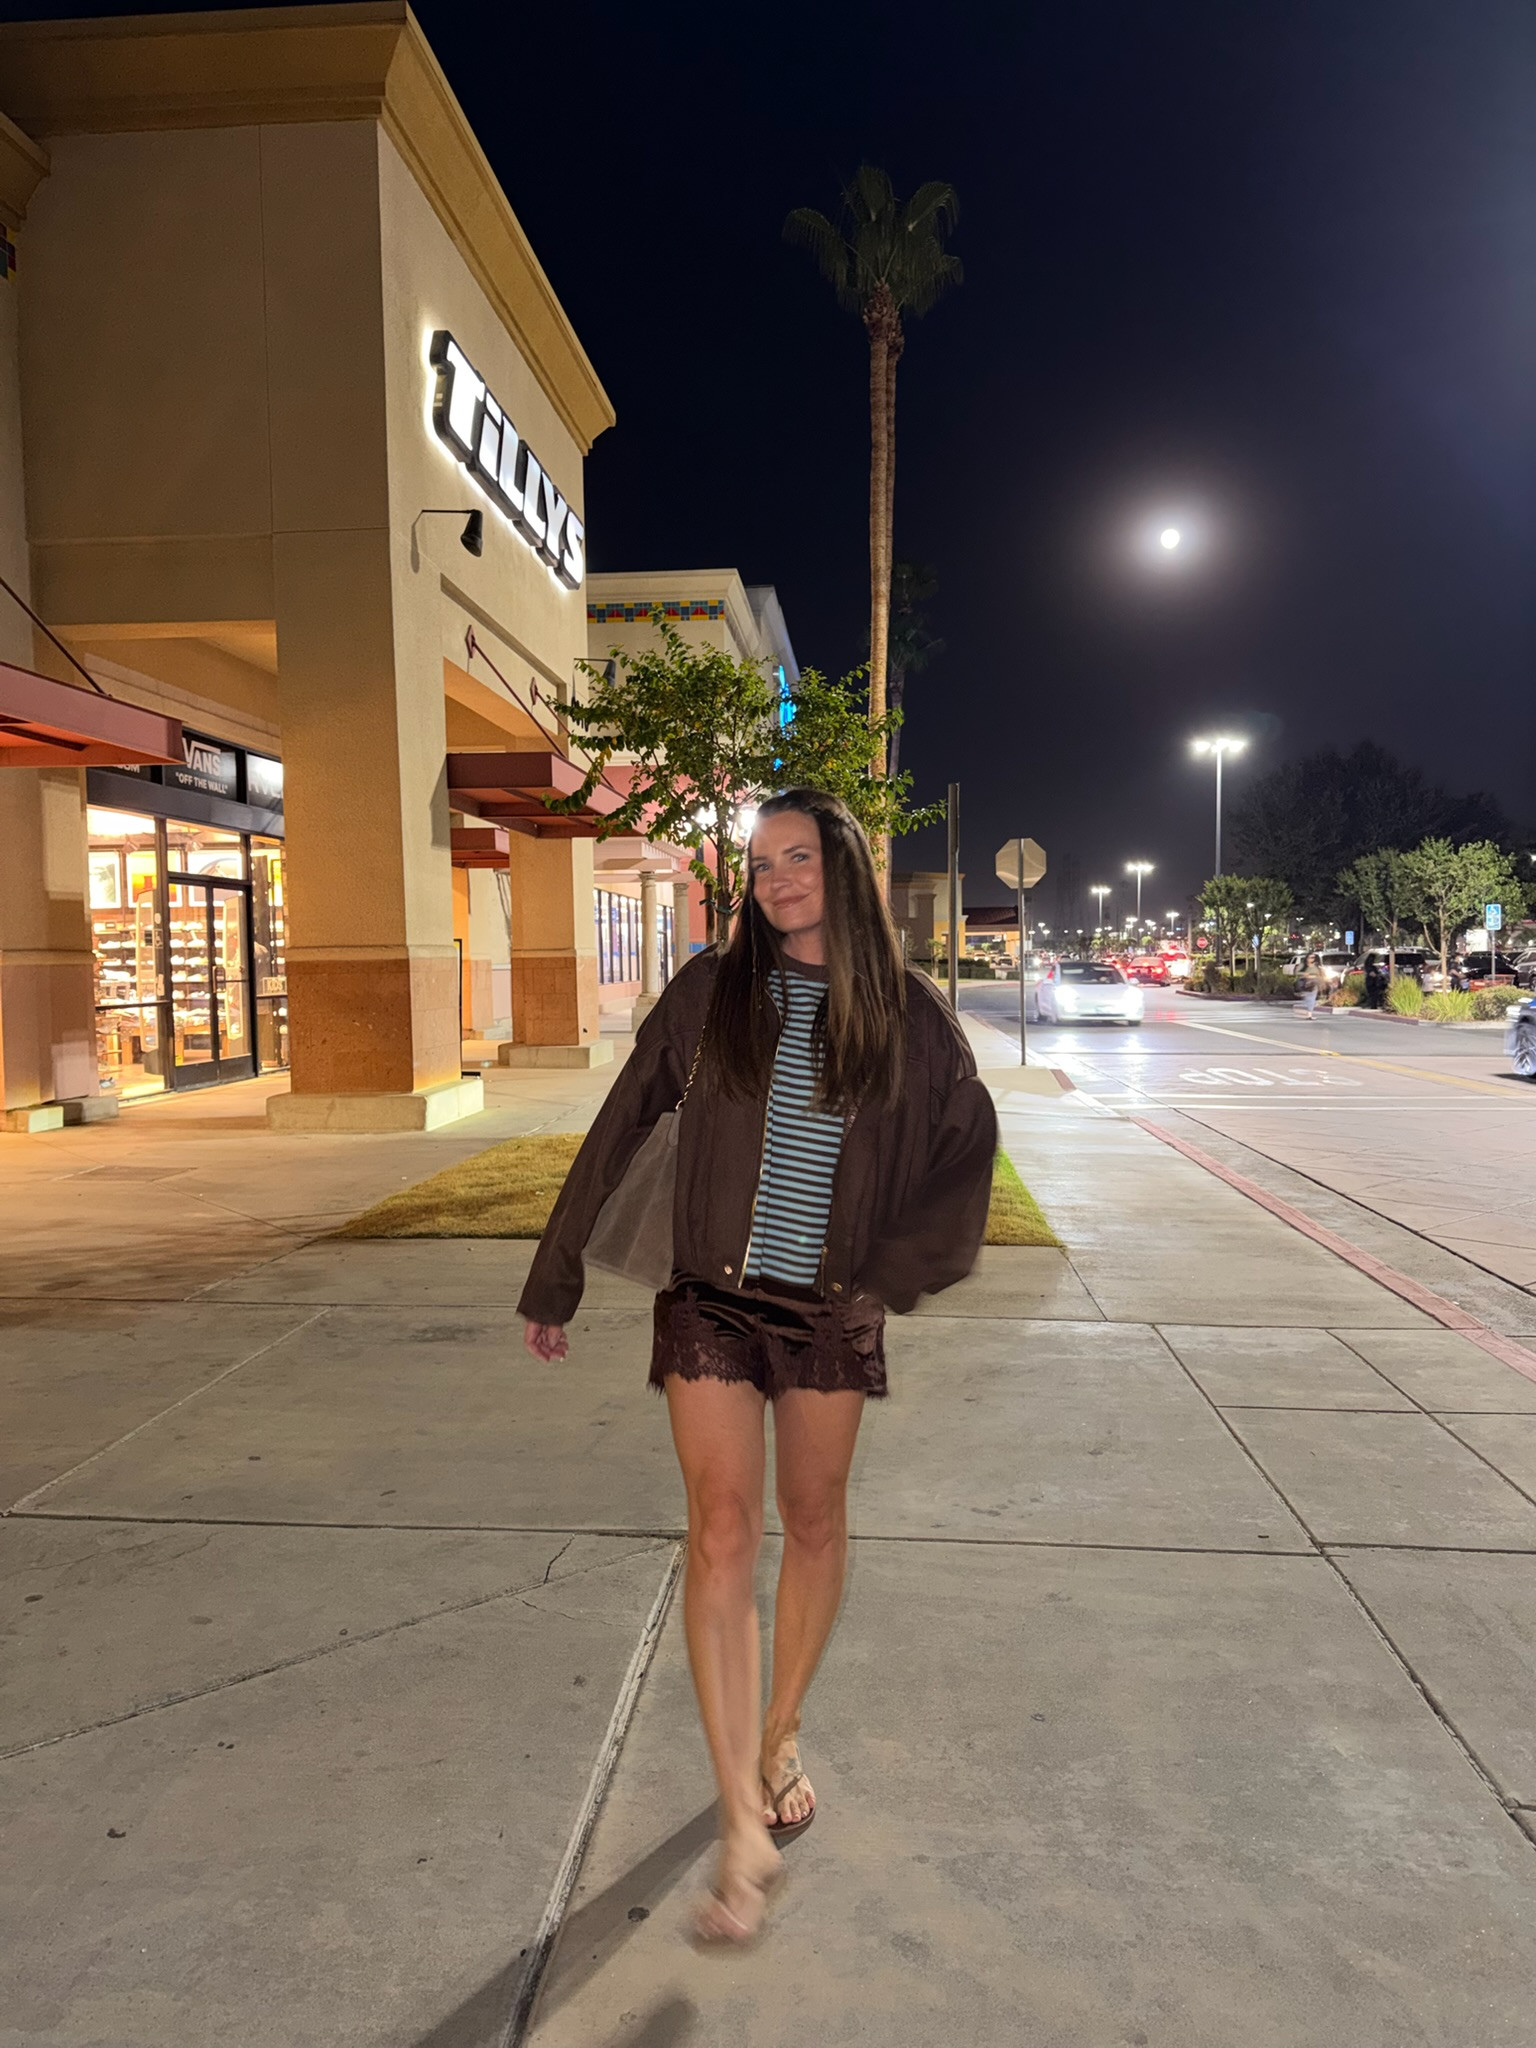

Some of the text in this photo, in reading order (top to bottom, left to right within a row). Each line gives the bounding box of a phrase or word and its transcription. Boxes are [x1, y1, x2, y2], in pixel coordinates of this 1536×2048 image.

[182, 736, 221, 777] VANS
[194, 776, 207, 789] THE
[1178, 1067, 1364, 1087] STOP
